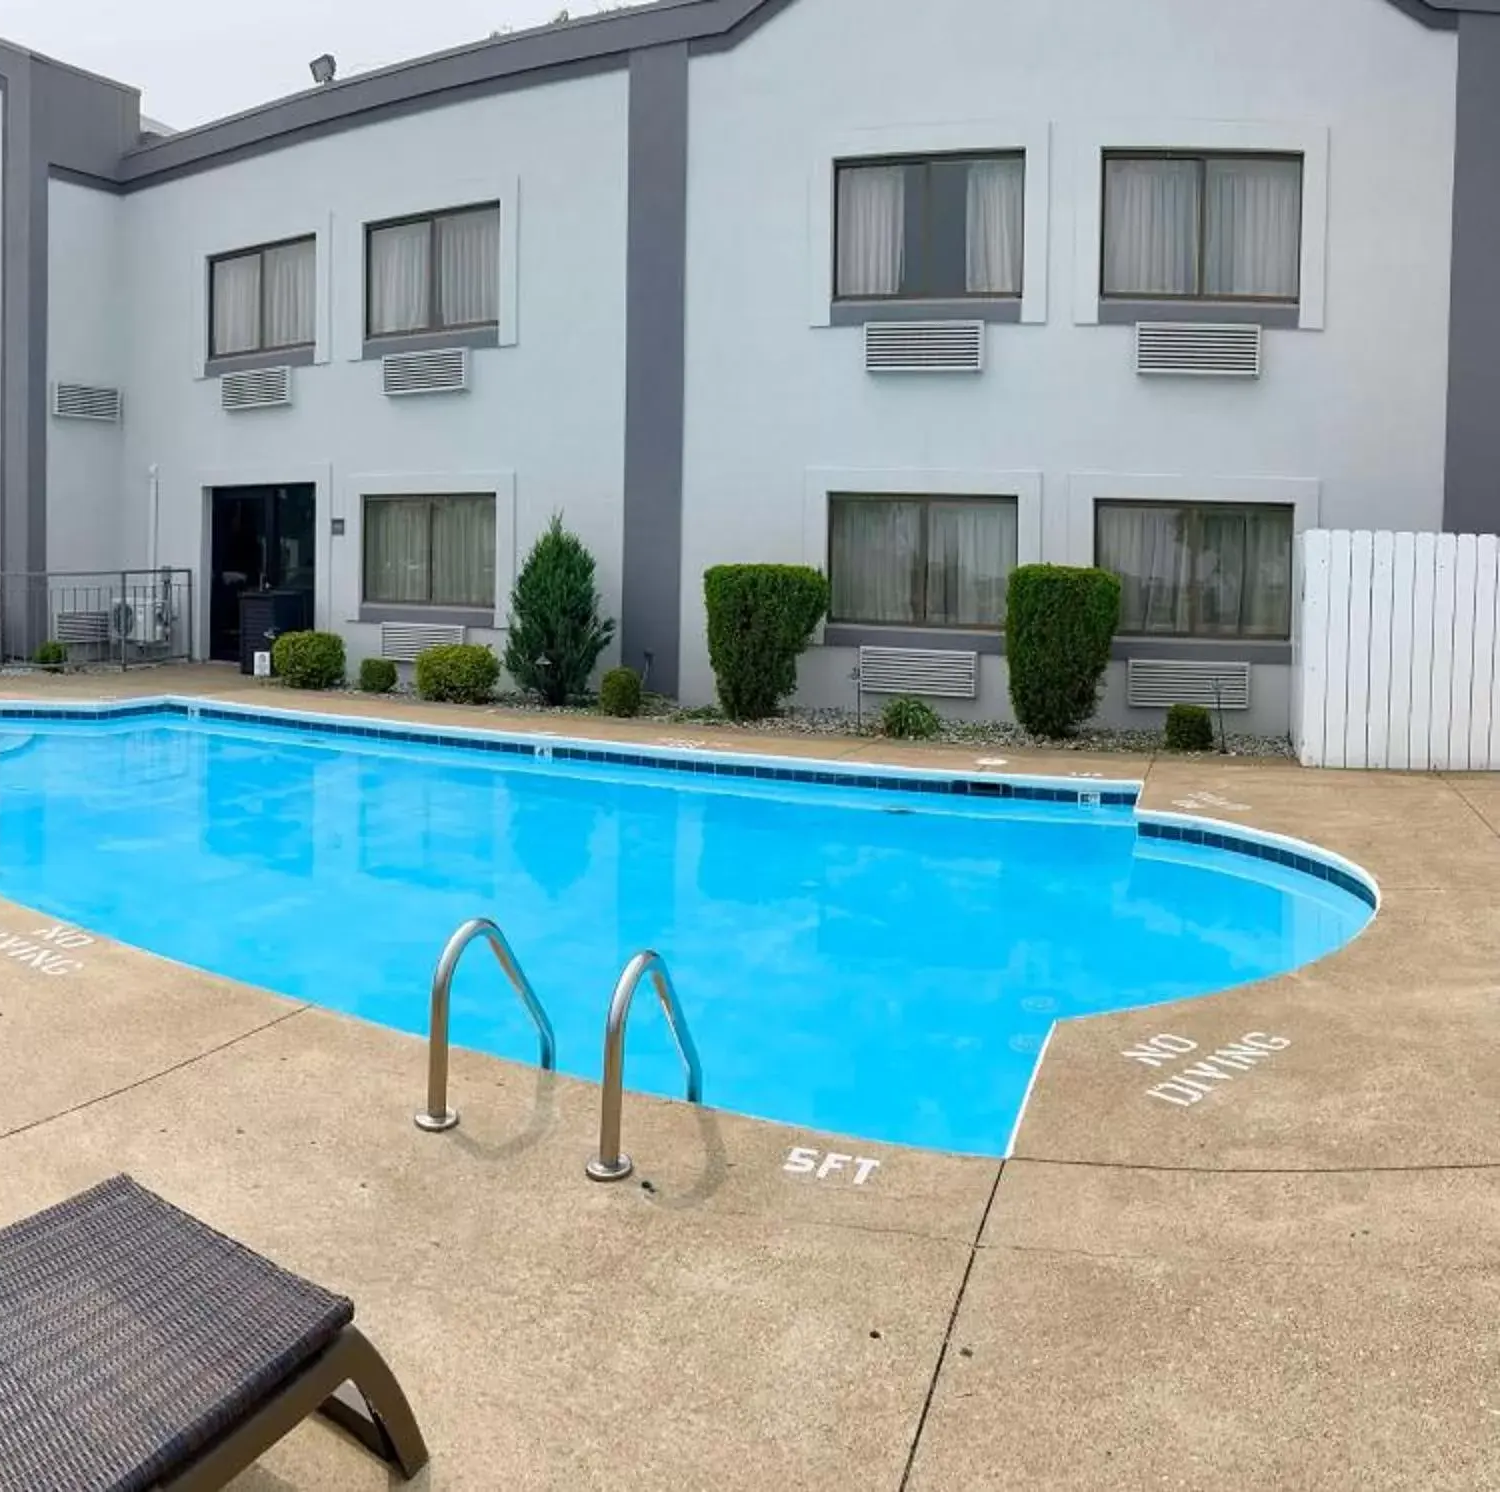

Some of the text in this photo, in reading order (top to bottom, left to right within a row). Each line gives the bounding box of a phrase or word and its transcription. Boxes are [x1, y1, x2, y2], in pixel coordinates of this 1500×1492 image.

[32, 925, 95, 948] NO
[1119, 1033, 1198, 1067] NO
[1145, 1032, 1291, 1107] DIVING
[783, 1147, 881, 1185] 5FT
